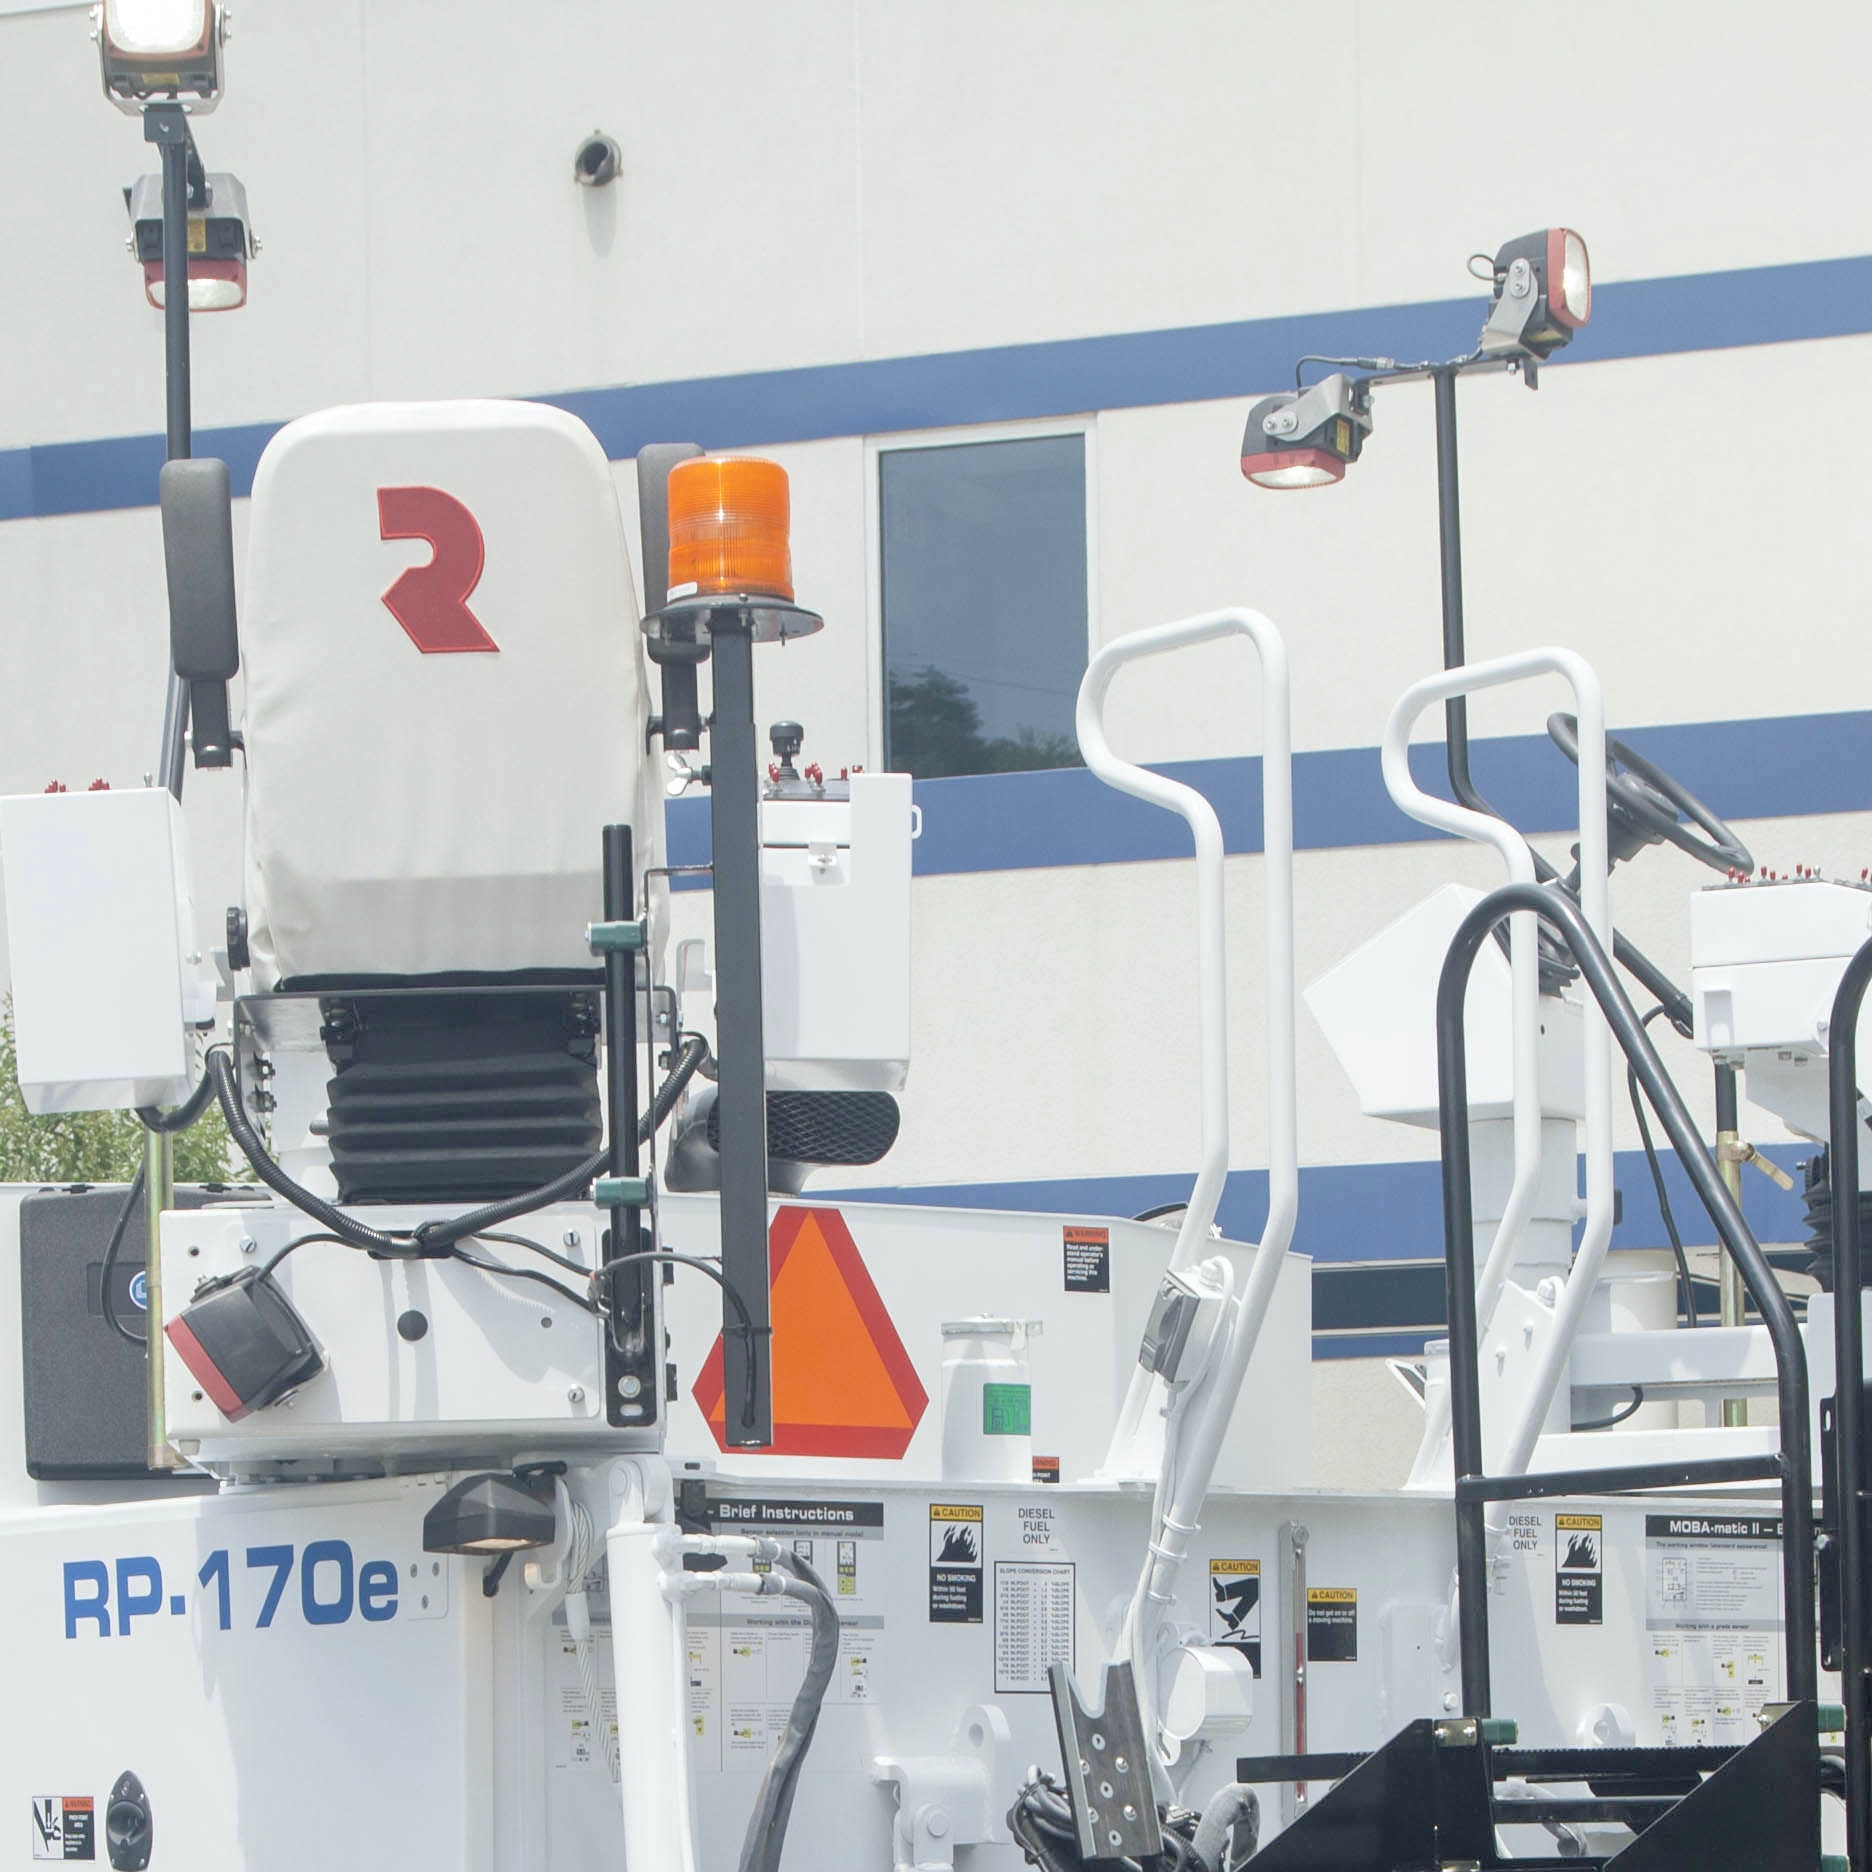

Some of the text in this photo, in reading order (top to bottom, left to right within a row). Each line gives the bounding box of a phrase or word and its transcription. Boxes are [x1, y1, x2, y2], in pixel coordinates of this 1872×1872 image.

[719, 1504, 854, 1521] Brief Instructions
[942, 1508, 980, 1518] CAUTION
[1018, 1508, 1055, 1519] DIESEL
[1508, 1516, 1542, 1526] DIESEL
[1023, 1521, 1050, 1532] FUEL
[1514, 1529, 1537, 1538] FUEL
[1023, 1534, 1050, 1544] ONLY
[1513, 1540, 1538, 1550] ONLY
[1221, 1563, 1258, 1572] CAUTION
[63, 1539, 399, 1639] RP-170e
[1320, 1591, 1353, 1599] CAUTION
